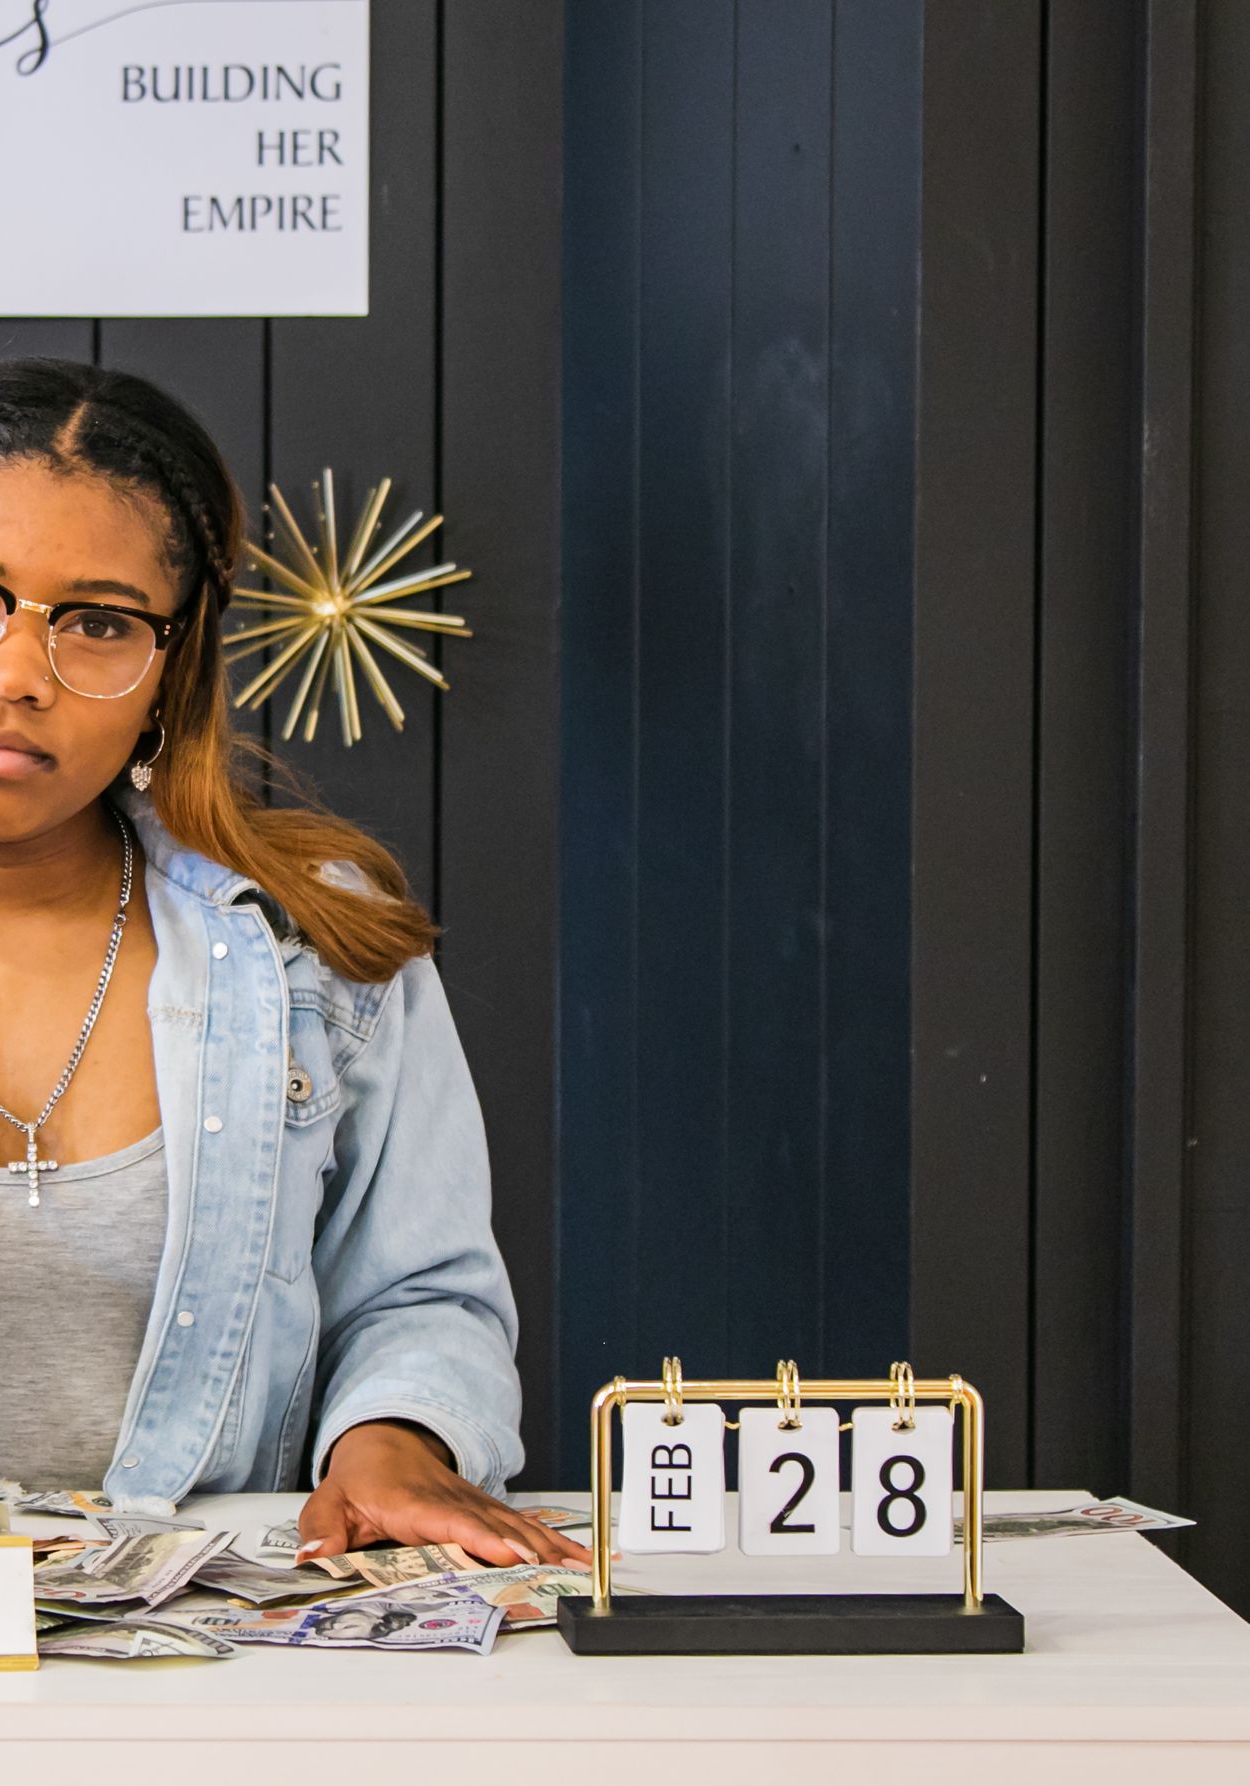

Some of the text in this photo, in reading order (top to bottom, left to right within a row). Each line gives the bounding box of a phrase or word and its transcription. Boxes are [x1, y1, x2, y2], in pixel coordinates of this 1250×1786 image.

[121, 64, 342, 103] BUILDING
[256, 130, 343, 167] HER
[181, 195, 343, 233] EMPIRE
[650, 1442, 928, 1538] FEB 2 8
